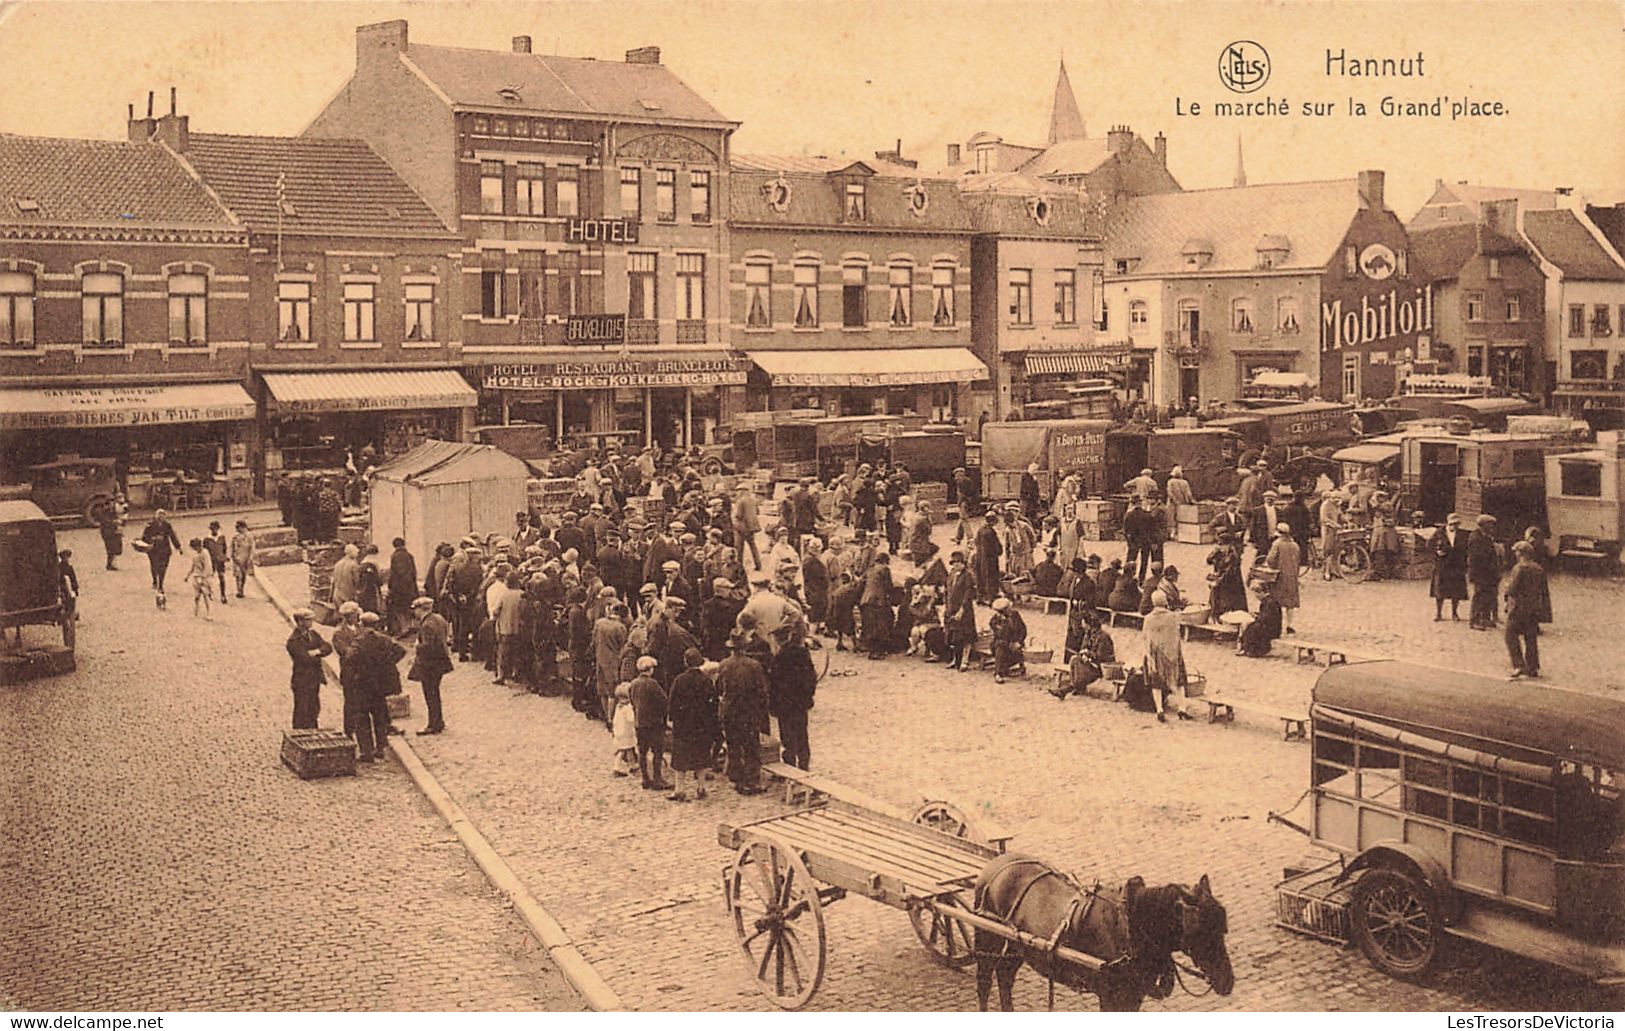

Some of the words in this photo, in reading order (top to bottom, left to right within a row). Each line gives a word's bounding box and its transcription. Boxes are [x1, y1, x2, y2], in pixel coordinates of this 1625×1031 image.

[570, 219, 636, 242] HOTEL
[1322, 283, 1432, 352] Mobiloil
[568, 319, 624, 340] BRUXELLOIS
[493, 364, 537, 375] HOTEL
[556, 362, 641, 375] RESTAURANT
[657, 360, 737, 372] BRUXELLOIS
[774, 374, 827, 385] BOCK
[131, 411, 160, 424] VAN
[165, 408, 200, 421] TILT
[1071, 455, 1100, 465] JAUCHE
